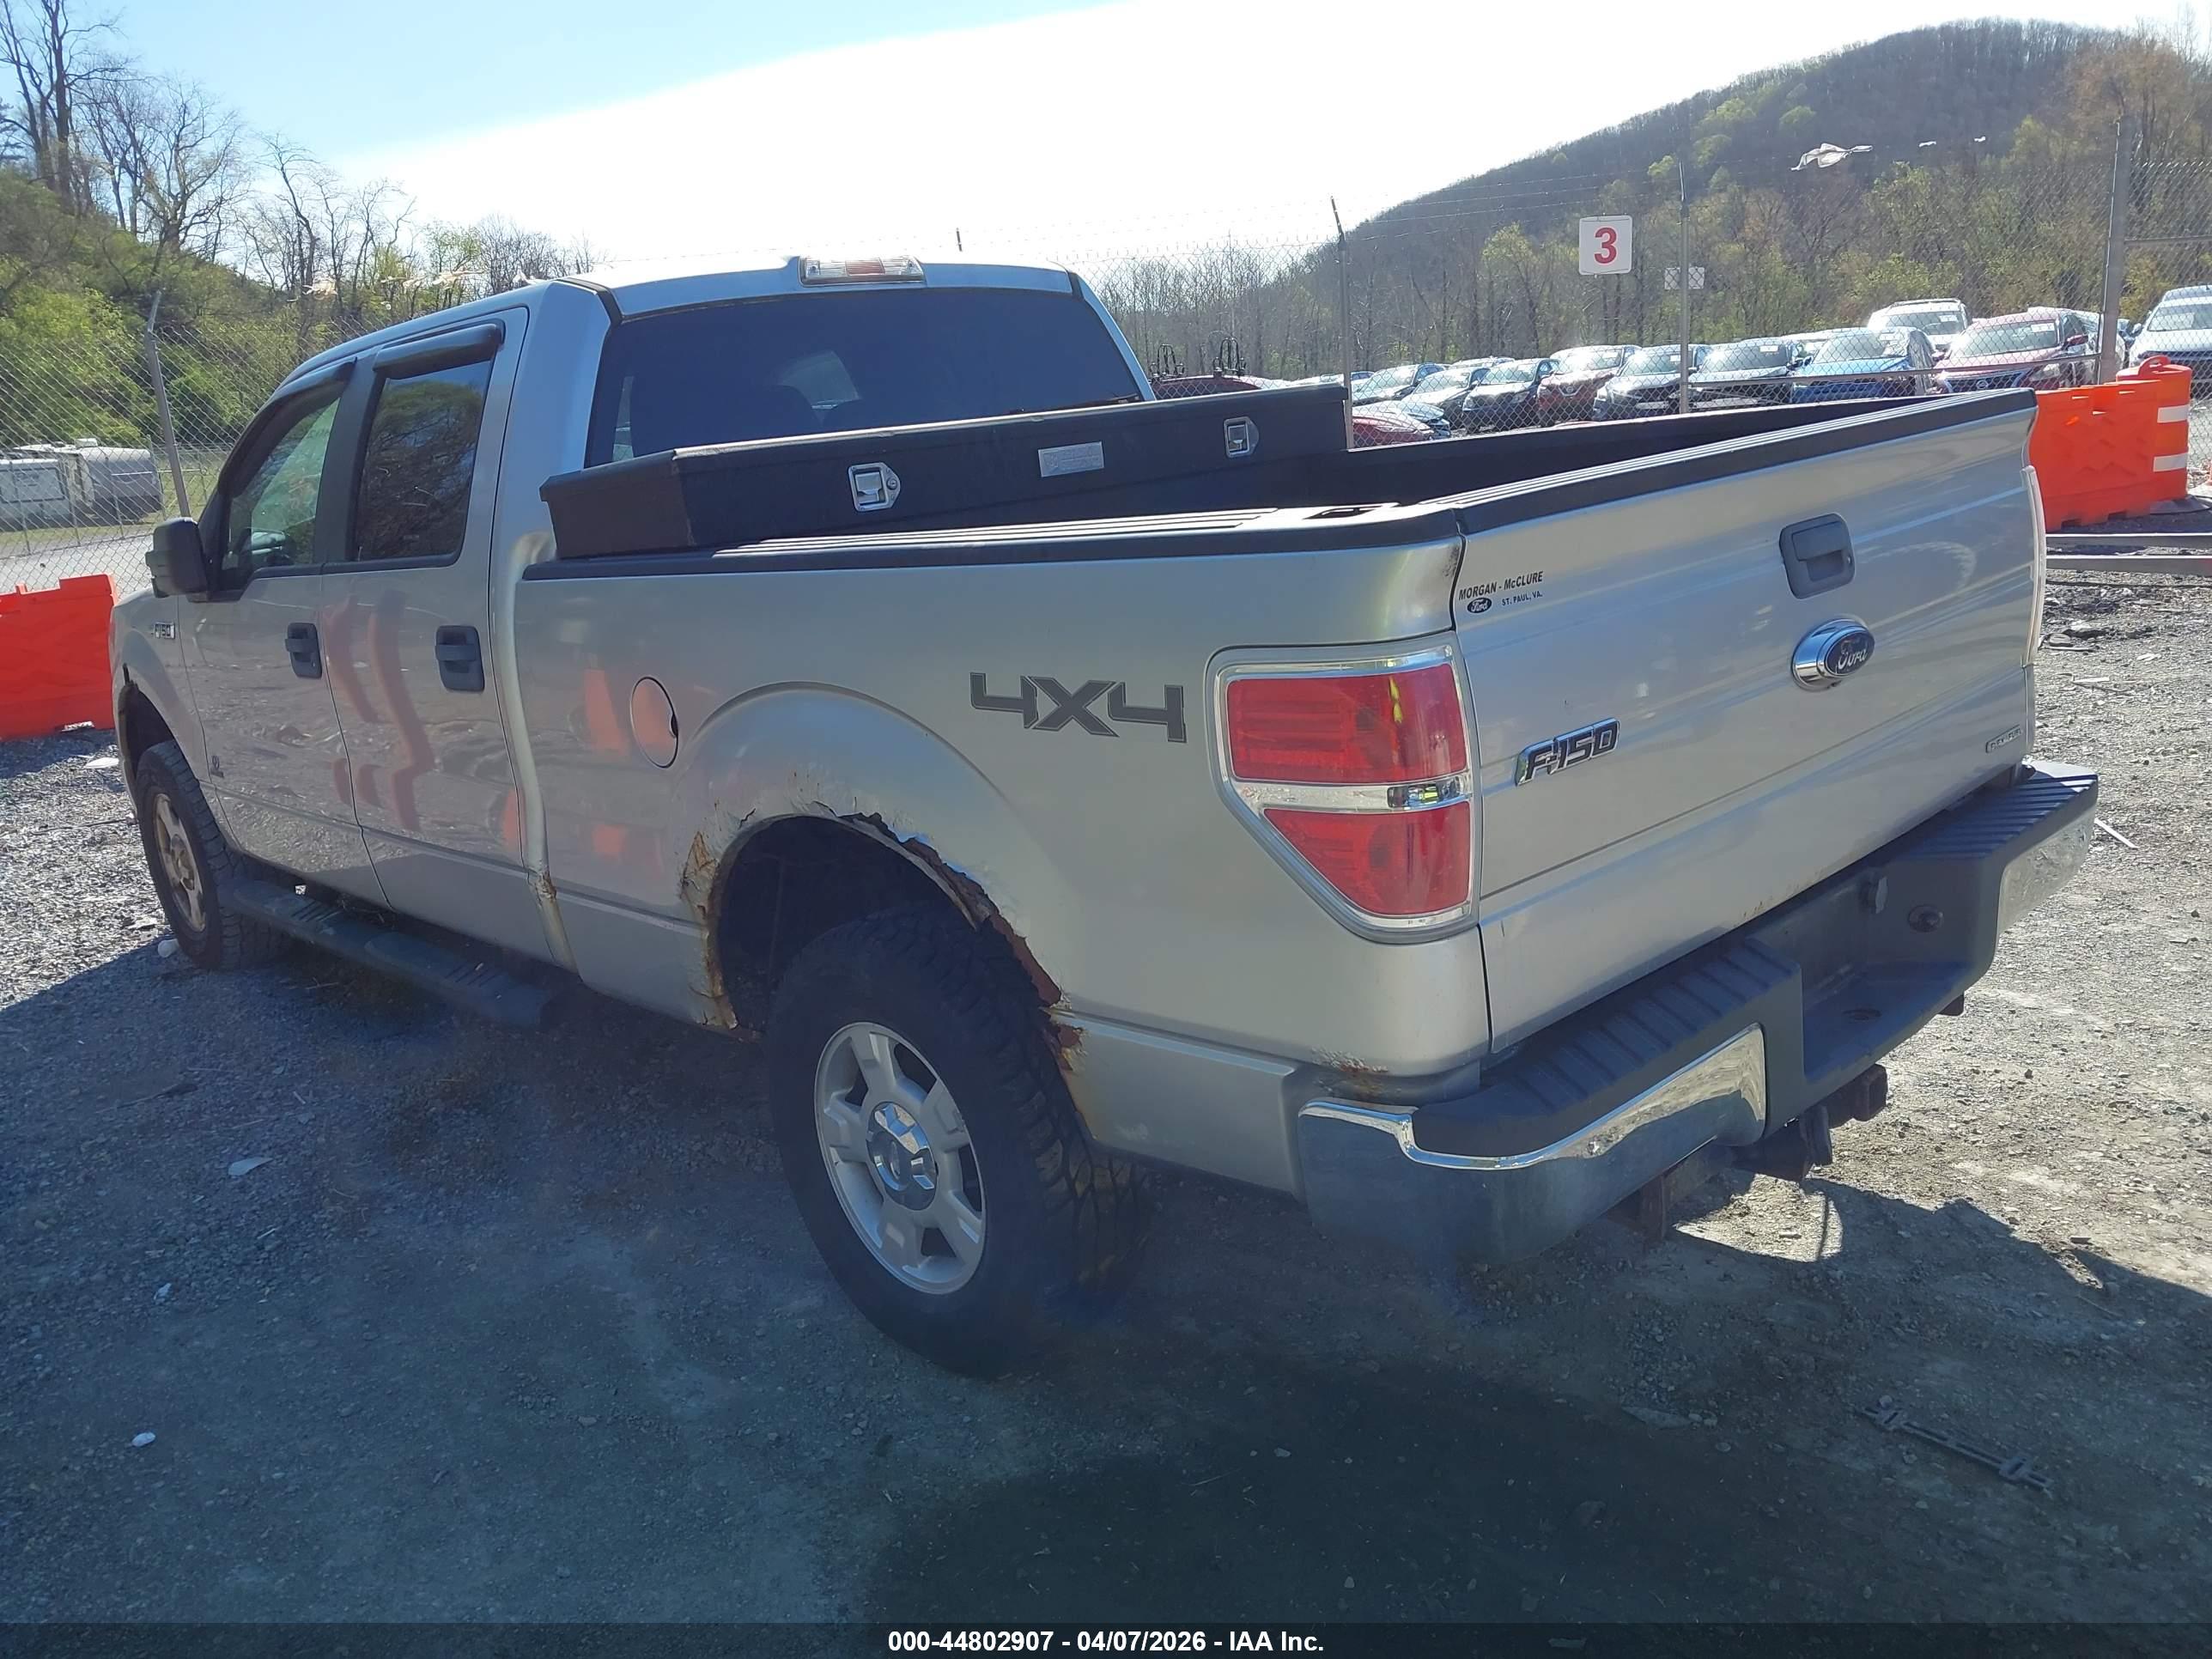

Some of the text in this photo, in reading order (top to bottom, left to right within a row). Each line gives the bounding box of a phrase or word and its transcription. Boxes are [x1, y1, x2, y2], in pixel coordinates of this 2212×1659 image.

[1594, 227, 1618, 264] 3
[1459, 581, 1498, 601] MORGAN
[1504, 571, 1544, 591] McCLURE
[1502, 590, 1543, 606] ST. PAUL, VA.
[1469, 599, 1490, 612] Ford
[1835, 639, 1869, 672] Ford
[970, 672, 1187, 743] 4X4
